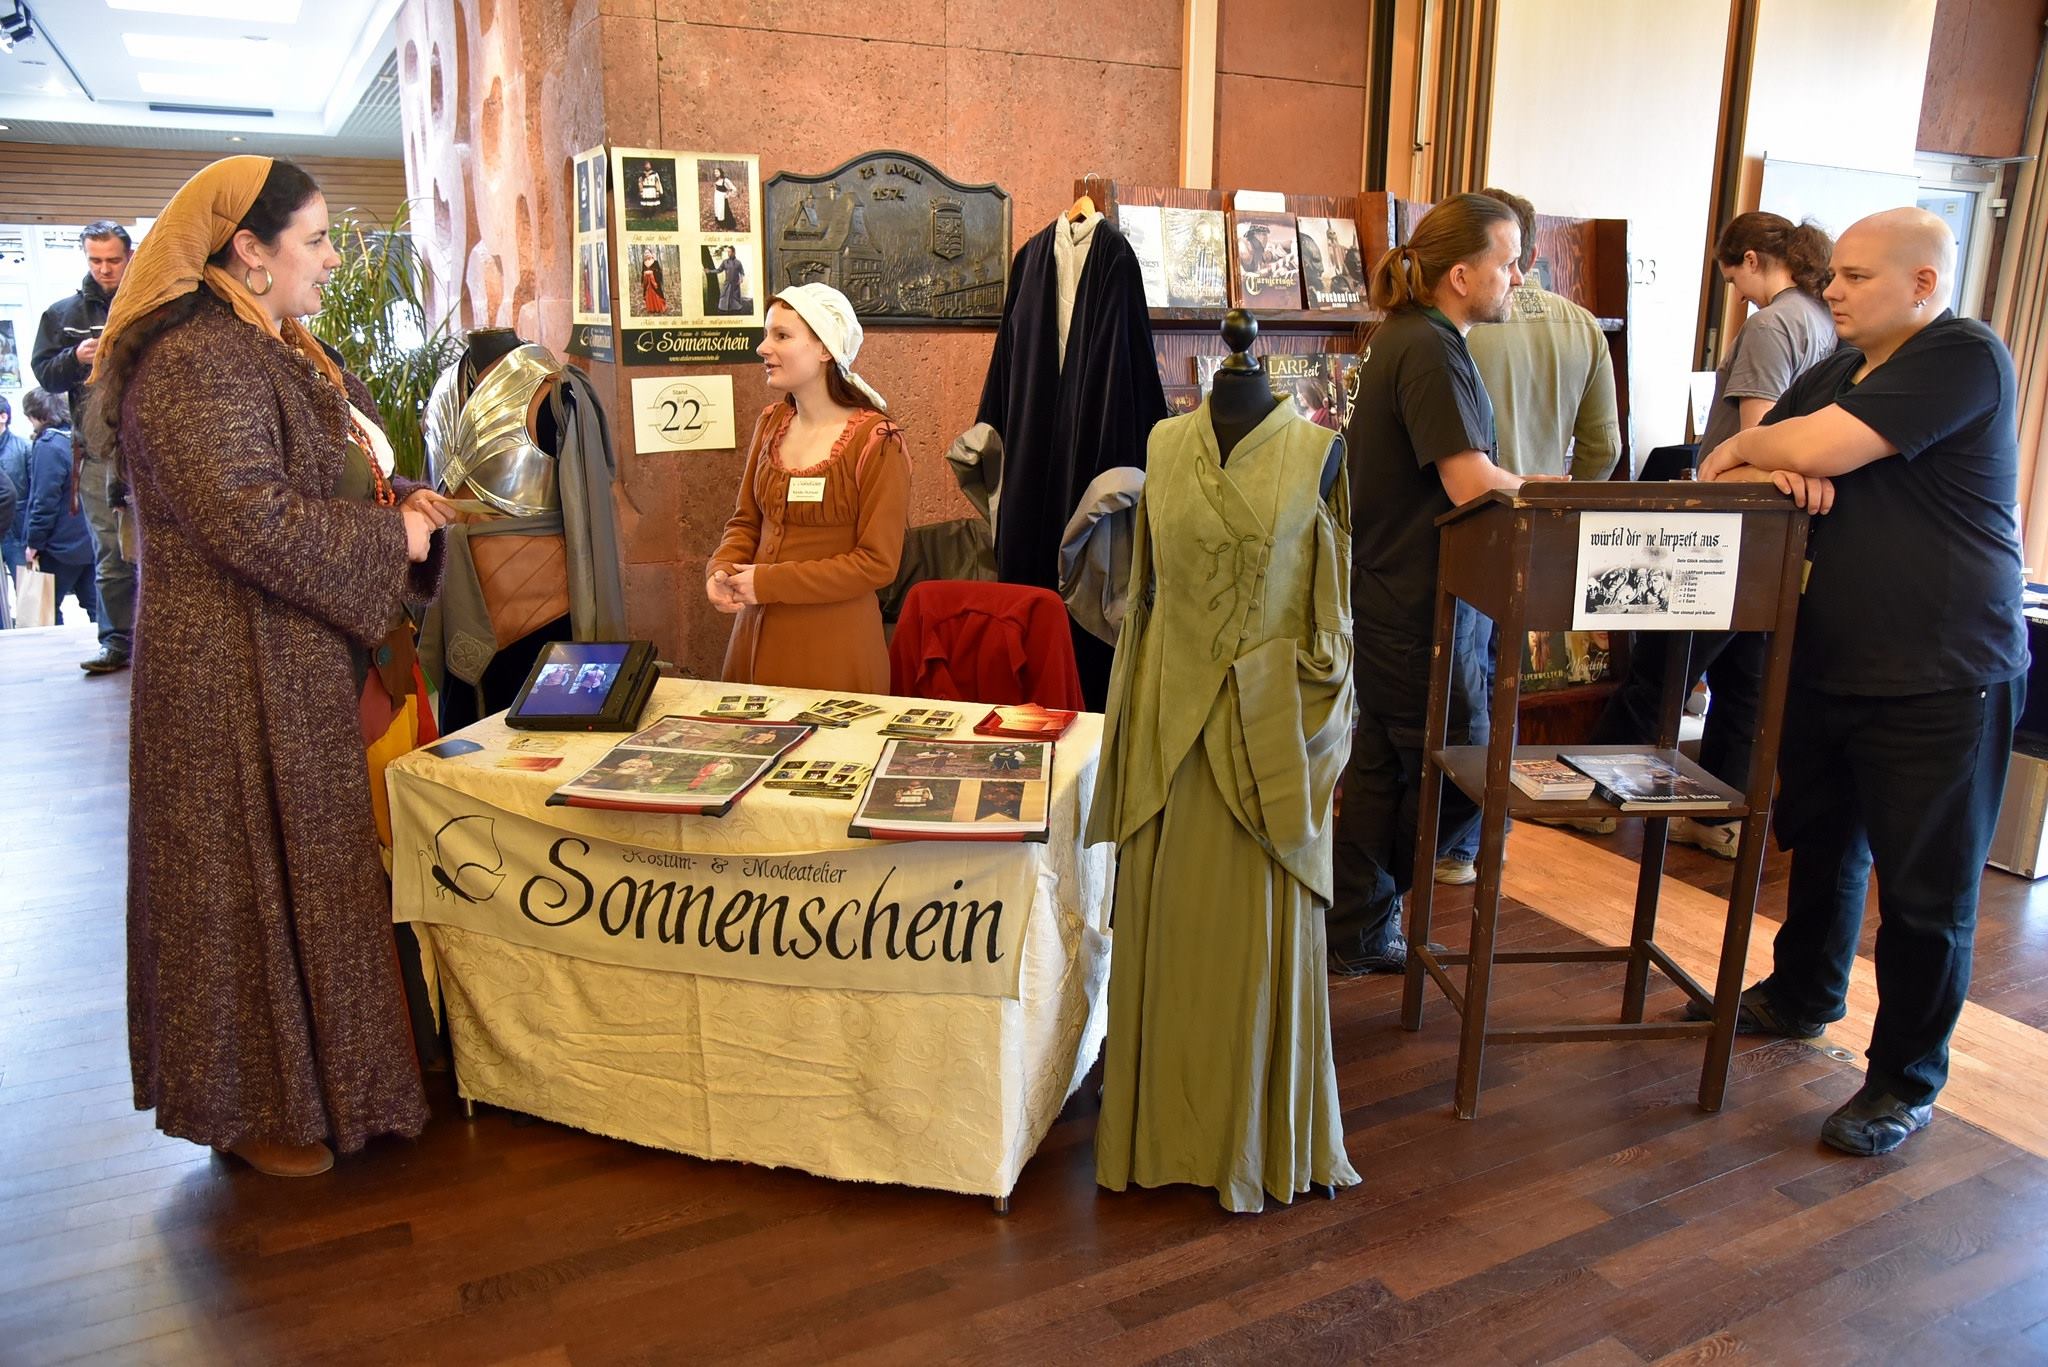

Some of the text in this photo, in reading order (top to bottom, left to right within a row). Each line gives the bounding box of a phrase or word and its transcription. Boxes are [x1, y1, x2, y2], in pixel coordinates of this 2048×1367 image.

[871, 187, 907, 201] 1974
[1633, 258, 1656, 285] 23
[656, 331, 750, 352] Sonnenschein
[1268, 359, 1321, 378] LARP zeit
[660, 399, 702, 432] 22
[1590, 527, 1624, 547] würfel
[1626, 527, 1642, 547] dir
[1659, 527, 1698, 553] larpzeit
[1700, 534, 1720, 547] aus
[711, 856, 729, 874] &
[743, 856, 848, 884] Modeatelier
[519, 837, 1005, 965] Sonnenschein
